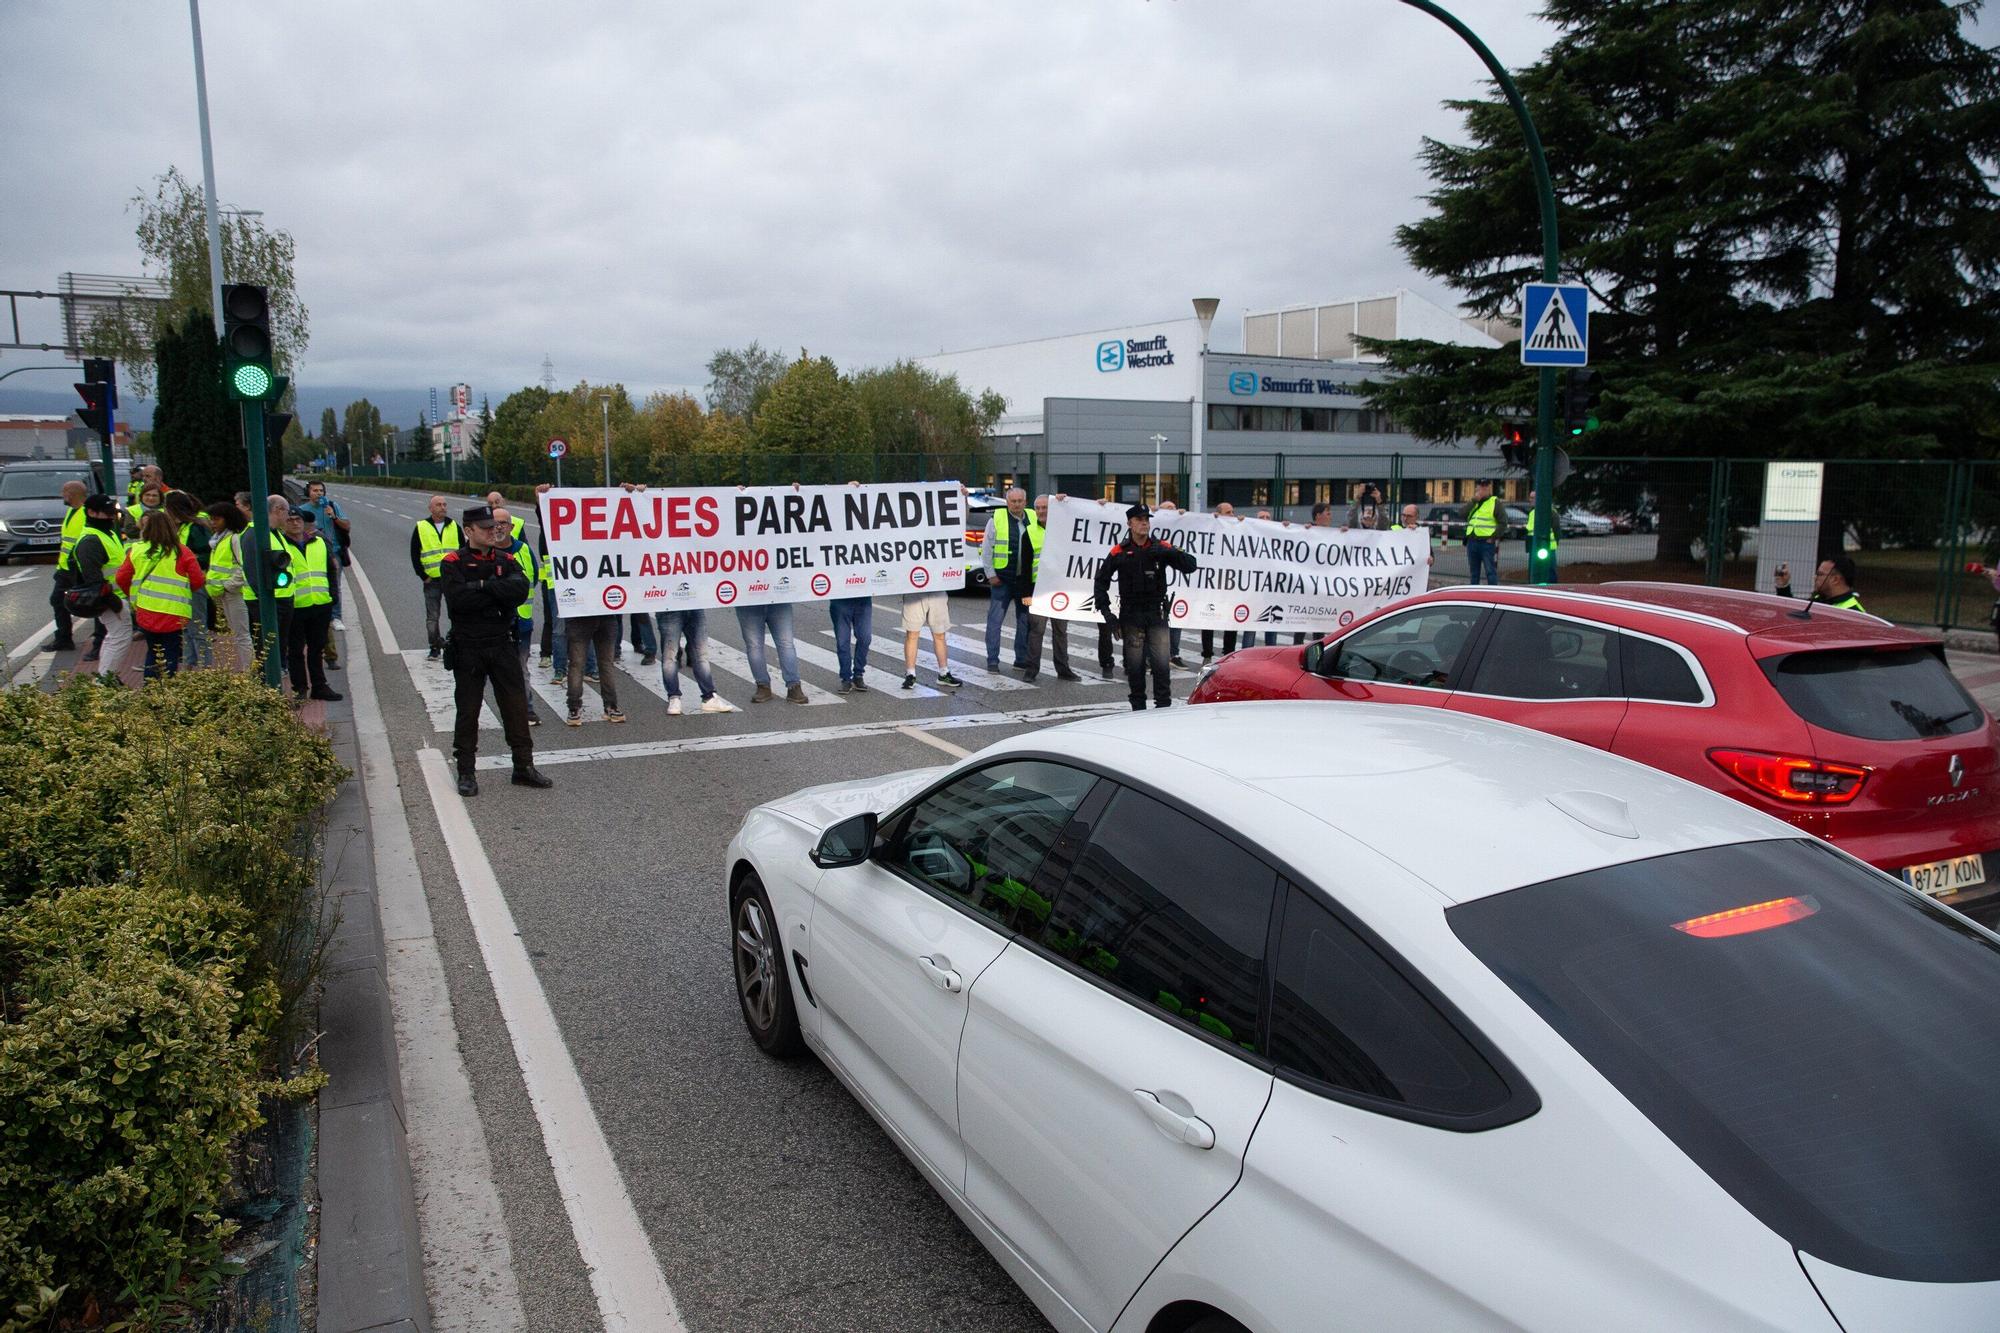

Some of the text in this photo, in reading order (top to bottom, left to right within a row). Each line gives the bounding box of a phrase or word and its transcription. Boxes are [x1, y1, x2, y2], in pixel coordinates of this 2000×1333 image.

[1127, 335, 1167, 353] Smurfit
[1127, 350, 1174, 368] Westrock
[1261, 376, 1315, 394] Smurfit
[552, 444, 565, 452] 50
[549, 489, 961, 541] PEAJES PARA NADIE
[1071, 518, 1415, 567] EL TRASPORTE NAVARRO CONTRA LA
[552, 538, 964, 580] NO AL ABANDONO DEL TRANSPORTE
[846, 577, 866, 585] HIRU
[942, 570, 962, 578] HIRU
[1196, 566, 1305, 595] TRIBUTARIA
[1309, 575, 1320, 596] Y
[1324, 575, 1359, 598] LOS
[1364, 575, 1413, 599] PEAJES
[644, 590, 667, 598] HIRU
[749, 584, 770, 592] HIRU
[1287, 604, 1338, 616] TRADISNA
[1914, 859, 1982, 891] 8727 KDN
